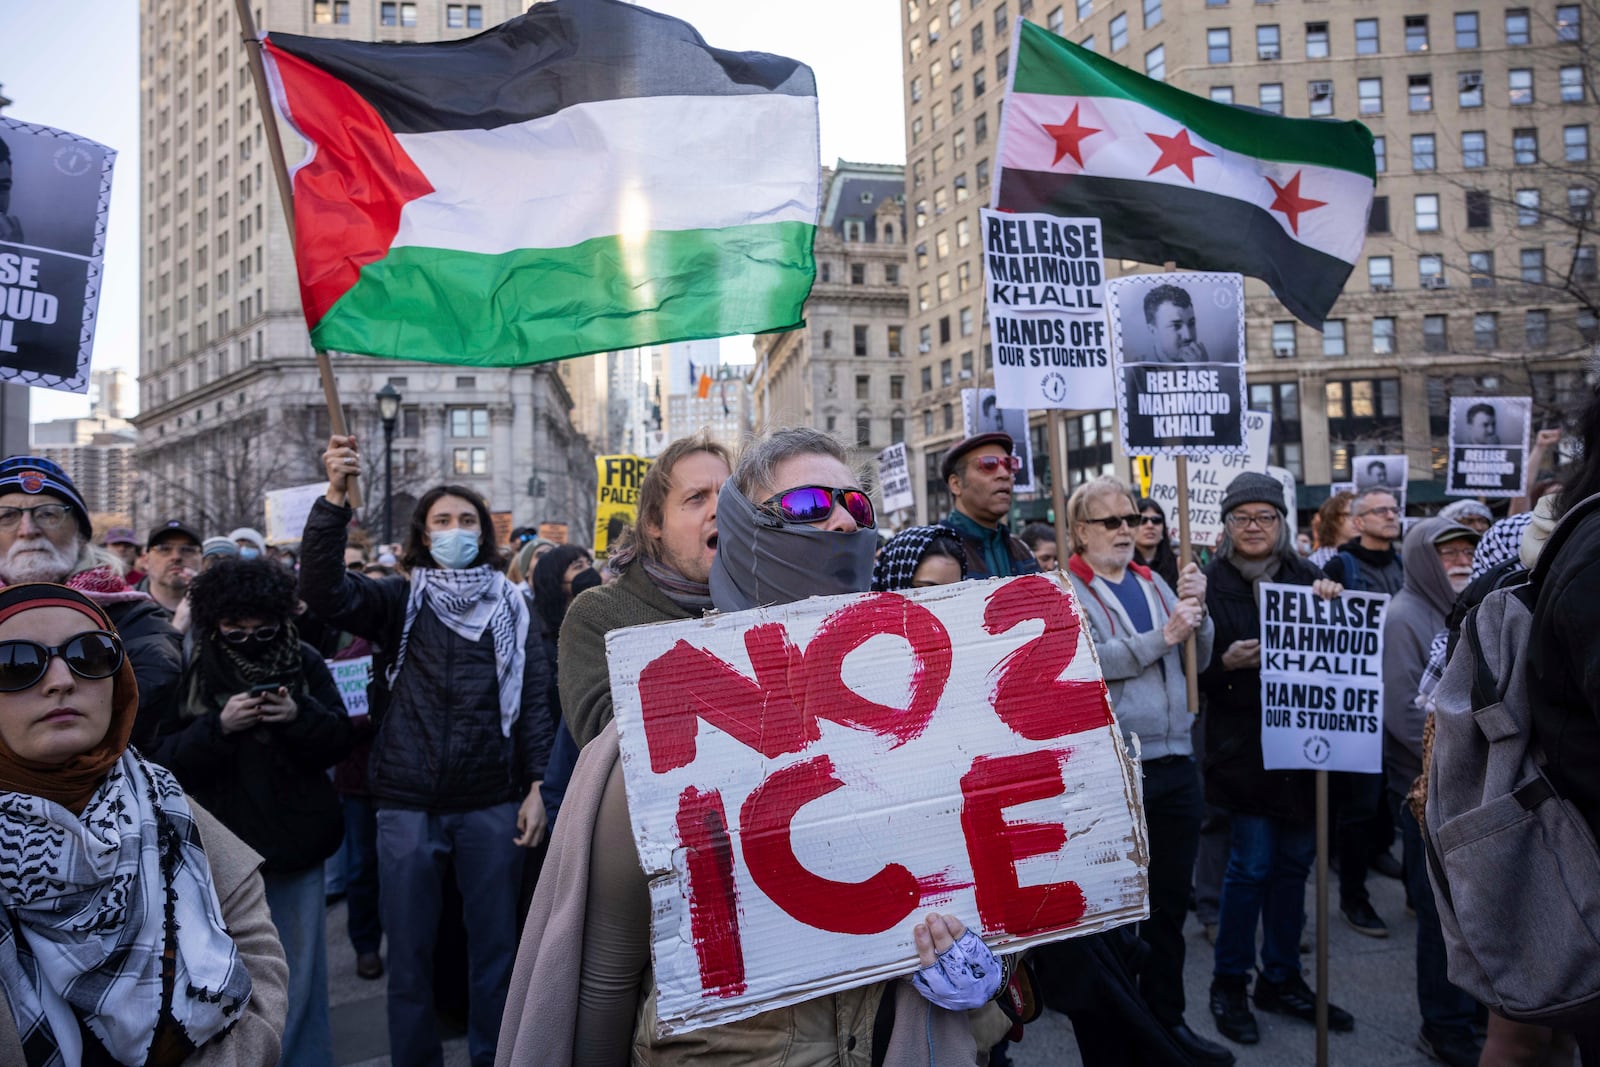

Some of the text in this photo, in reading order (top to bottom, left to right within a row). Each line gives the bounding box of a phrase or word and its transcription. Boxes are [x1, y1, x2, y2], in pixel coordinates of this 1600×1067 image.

[987, 216, 1100, 259] RELEASE
[988, 253, 1101, 287] MAHMOUD
[993, 283, 1102, 308] KHALIL
[996, 317, 1105, 347] HANDS OFF
[998, 345, 1108, 368] OUR STUDENTS
[1146, 370, 1219, 393] RELEASE
[1138, 392, 1230, 416] MAHMOUD
[1152, 415, 1215, 438] KHALIL
[1222, 454, 1251, 469] OFF
[1191, 469, 1219, 486] ALL
[1265, 588, 1384, 630] RELEASE
[1265, 624, 1379, 656] MAHMOUD
[638, 575, 1115, 775] NO 2
[1266, 652, 1378, 677] KHALIL
[1266, 682, 1379, 713] HANDS OFF
[1265, 708, 1379, 734] OUR STUDENTS
[675, 748, 1087, 999] ICE
